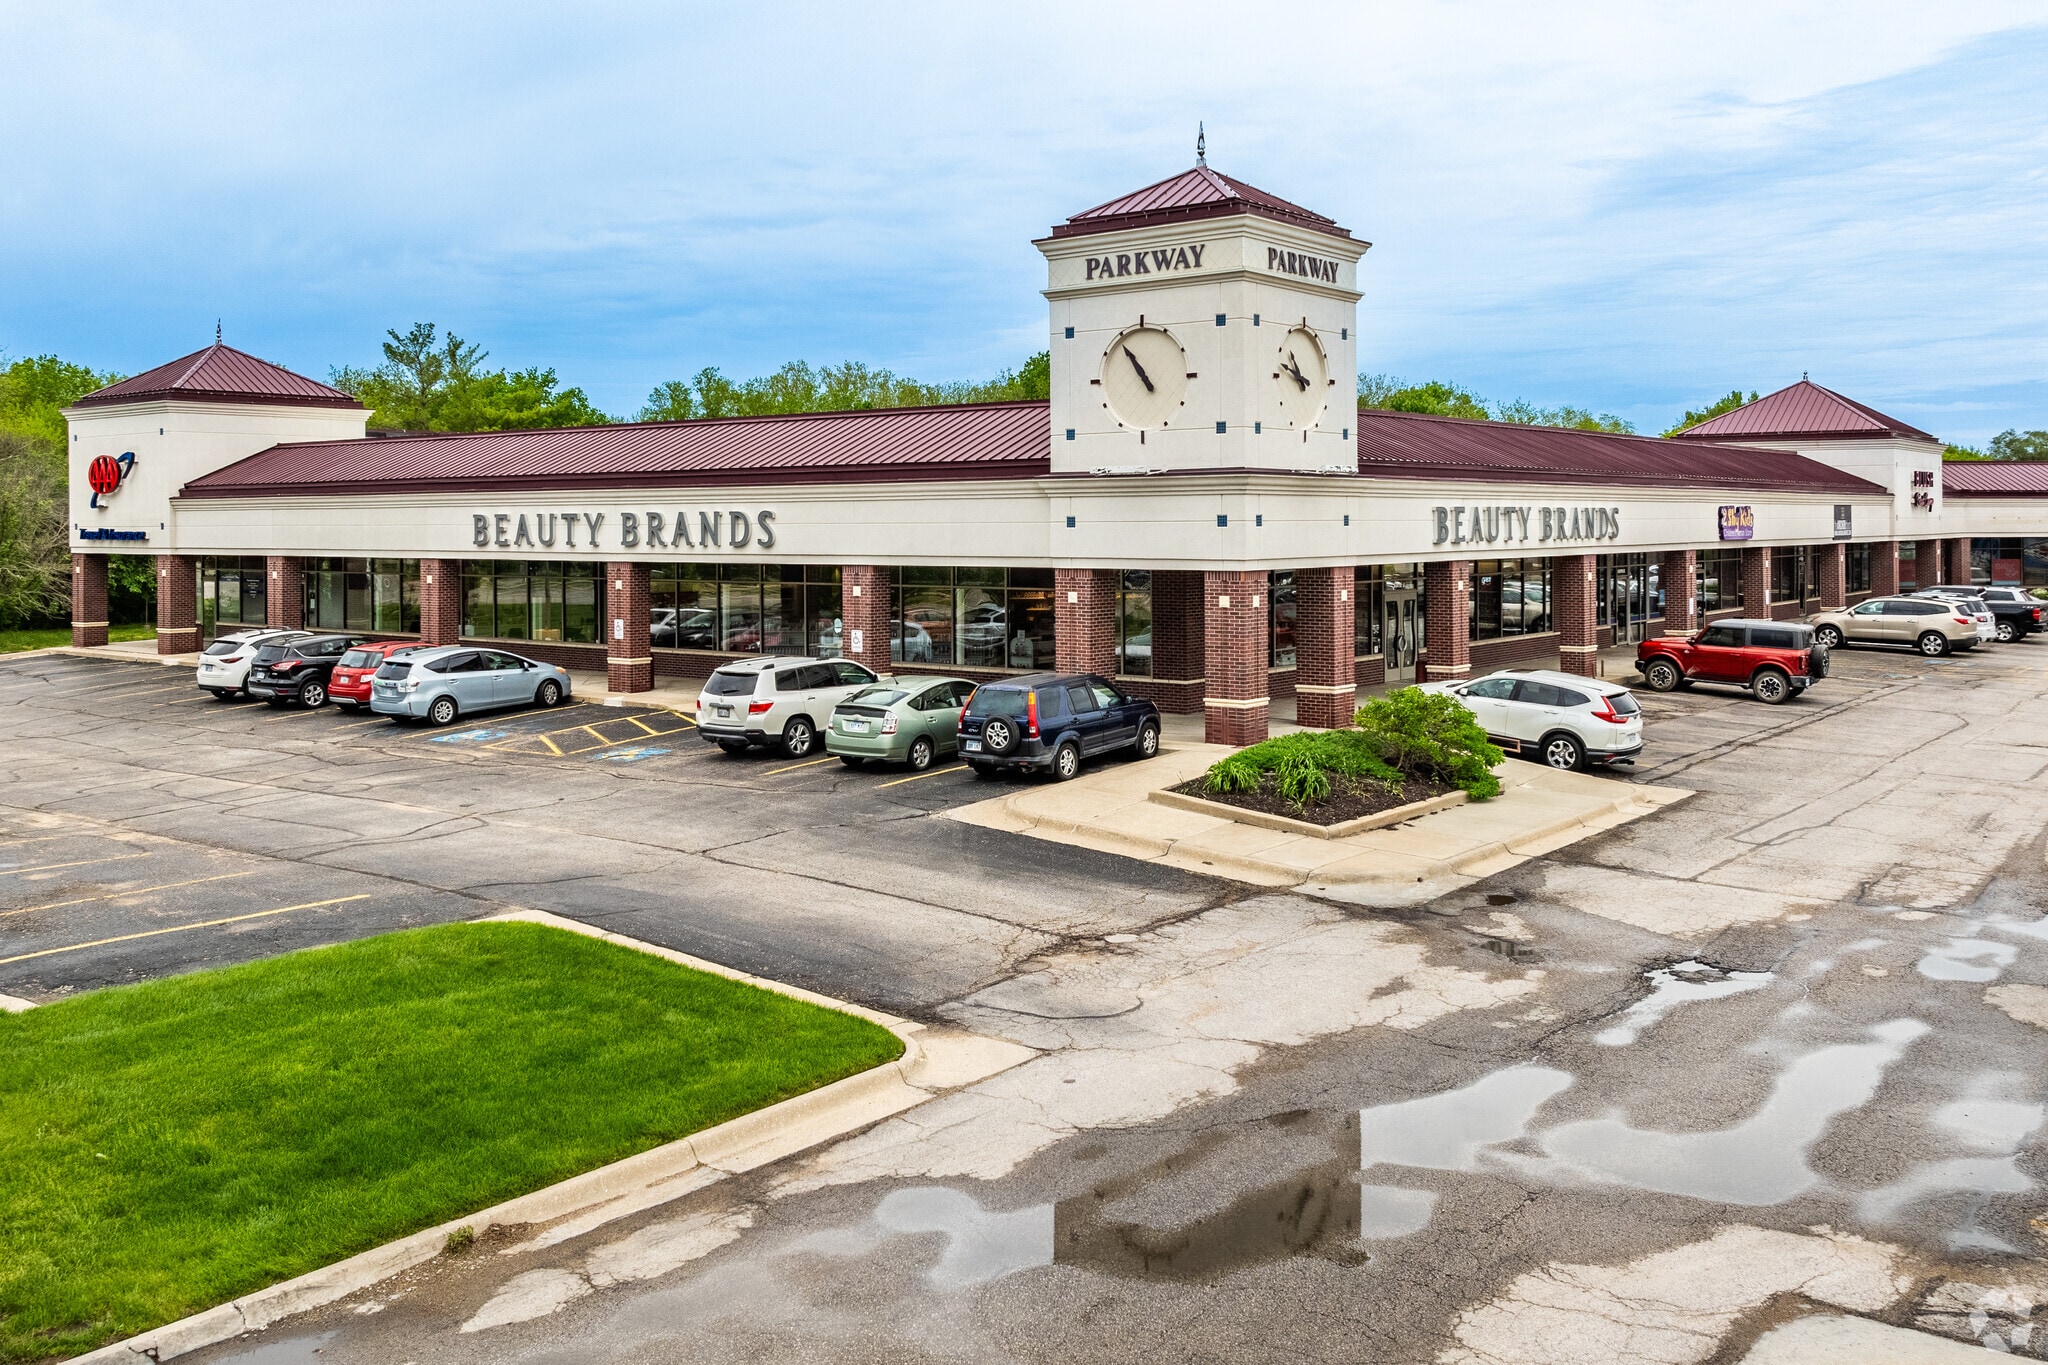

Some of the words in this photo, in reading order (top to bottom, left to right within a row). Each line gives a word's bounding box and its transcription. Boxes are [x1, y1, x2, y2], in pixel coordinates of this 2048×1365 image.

[1085, 244, 1206, 280] PARKWAY
[1267, 247, 1340, 284] PARKWAY
[88, 455, 121, 494] AAA
[472, 513, 605, 547] BEAUTY
[621, 510, 777, 549] BRANDS
[1432, 506, 1532, 545] BEAUTY
[1539, 507, 1620, 541] BRANDS
[1721, 508, 1728, 526] 2
[1740, 507, 1753, 527] Kids
